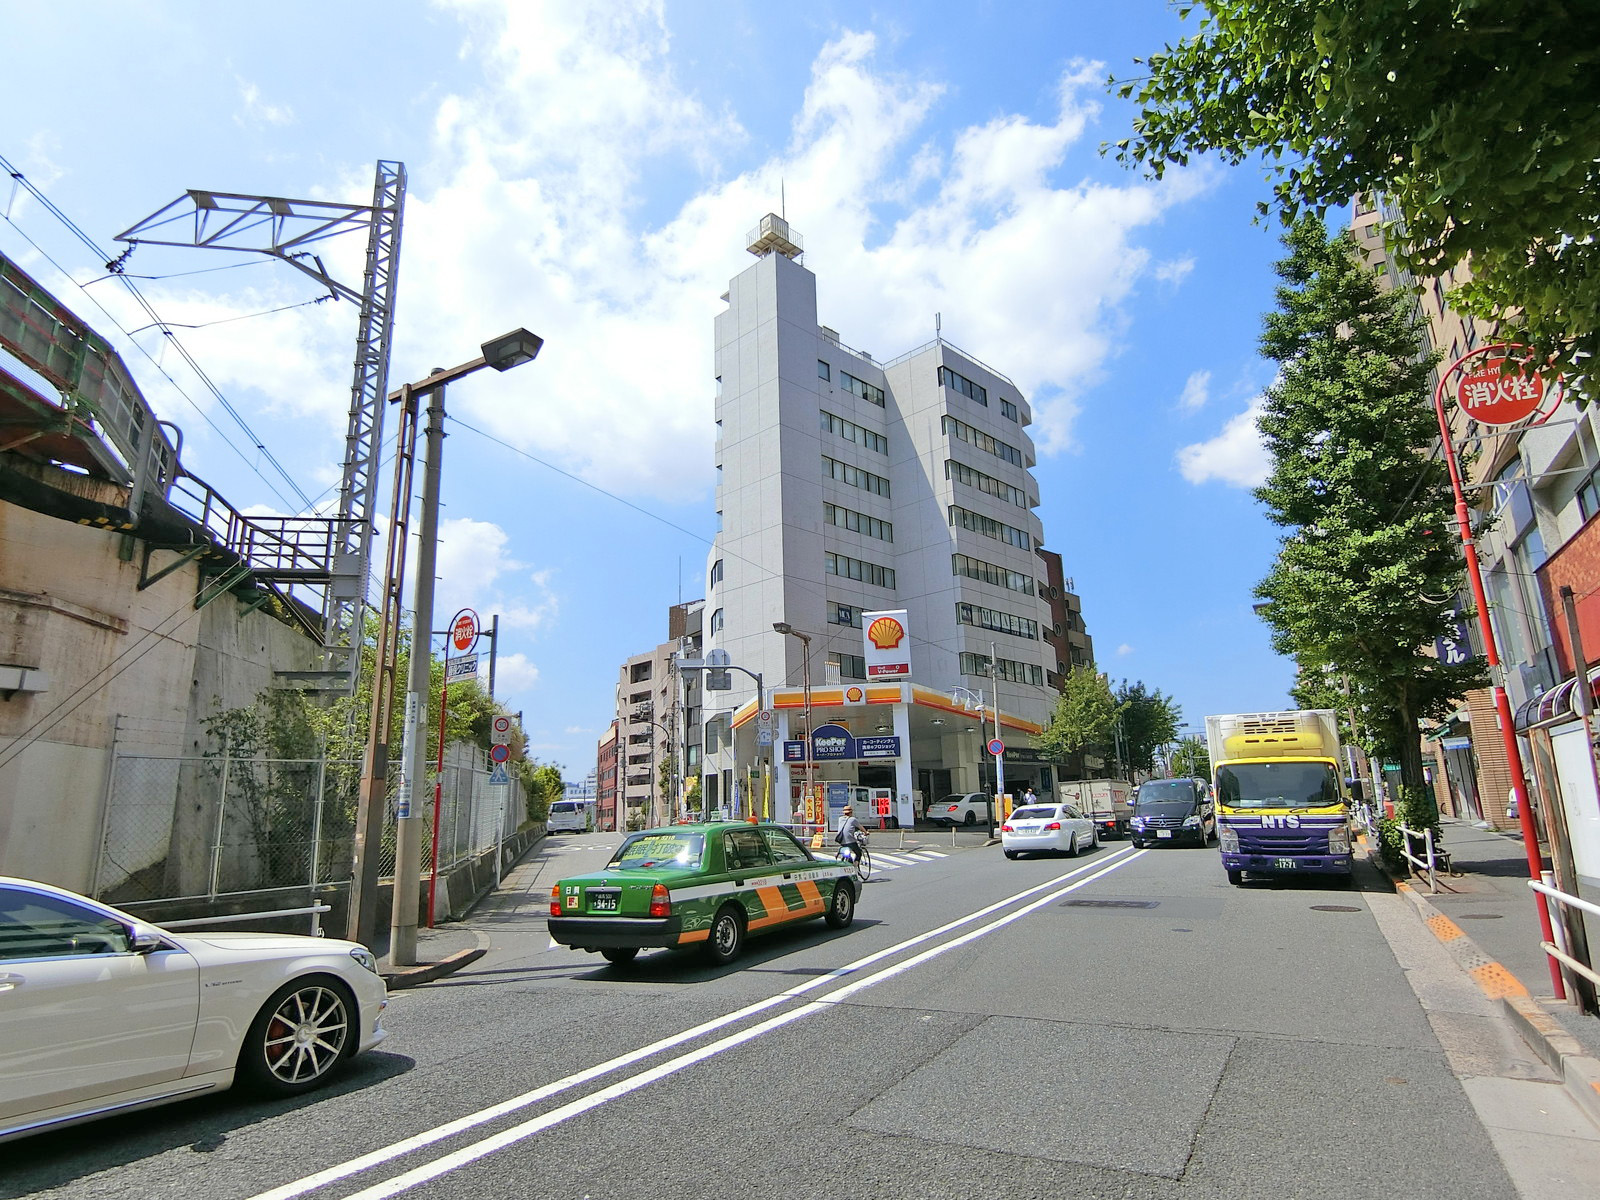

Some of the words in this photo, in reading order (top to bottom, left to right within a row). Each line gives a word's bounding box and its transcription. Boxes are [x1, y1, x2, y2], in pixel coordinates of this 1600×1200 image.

[1463, 375, 1539, 409] 消火栓
[455, 625, 474, 641] 消火栓
[815, 737, 847, 747] KeePer
[807, 807, 813, 818] 入口
[1260, 815, 1300, 829] NTS
[596, 899, 616, 909] 94-15
